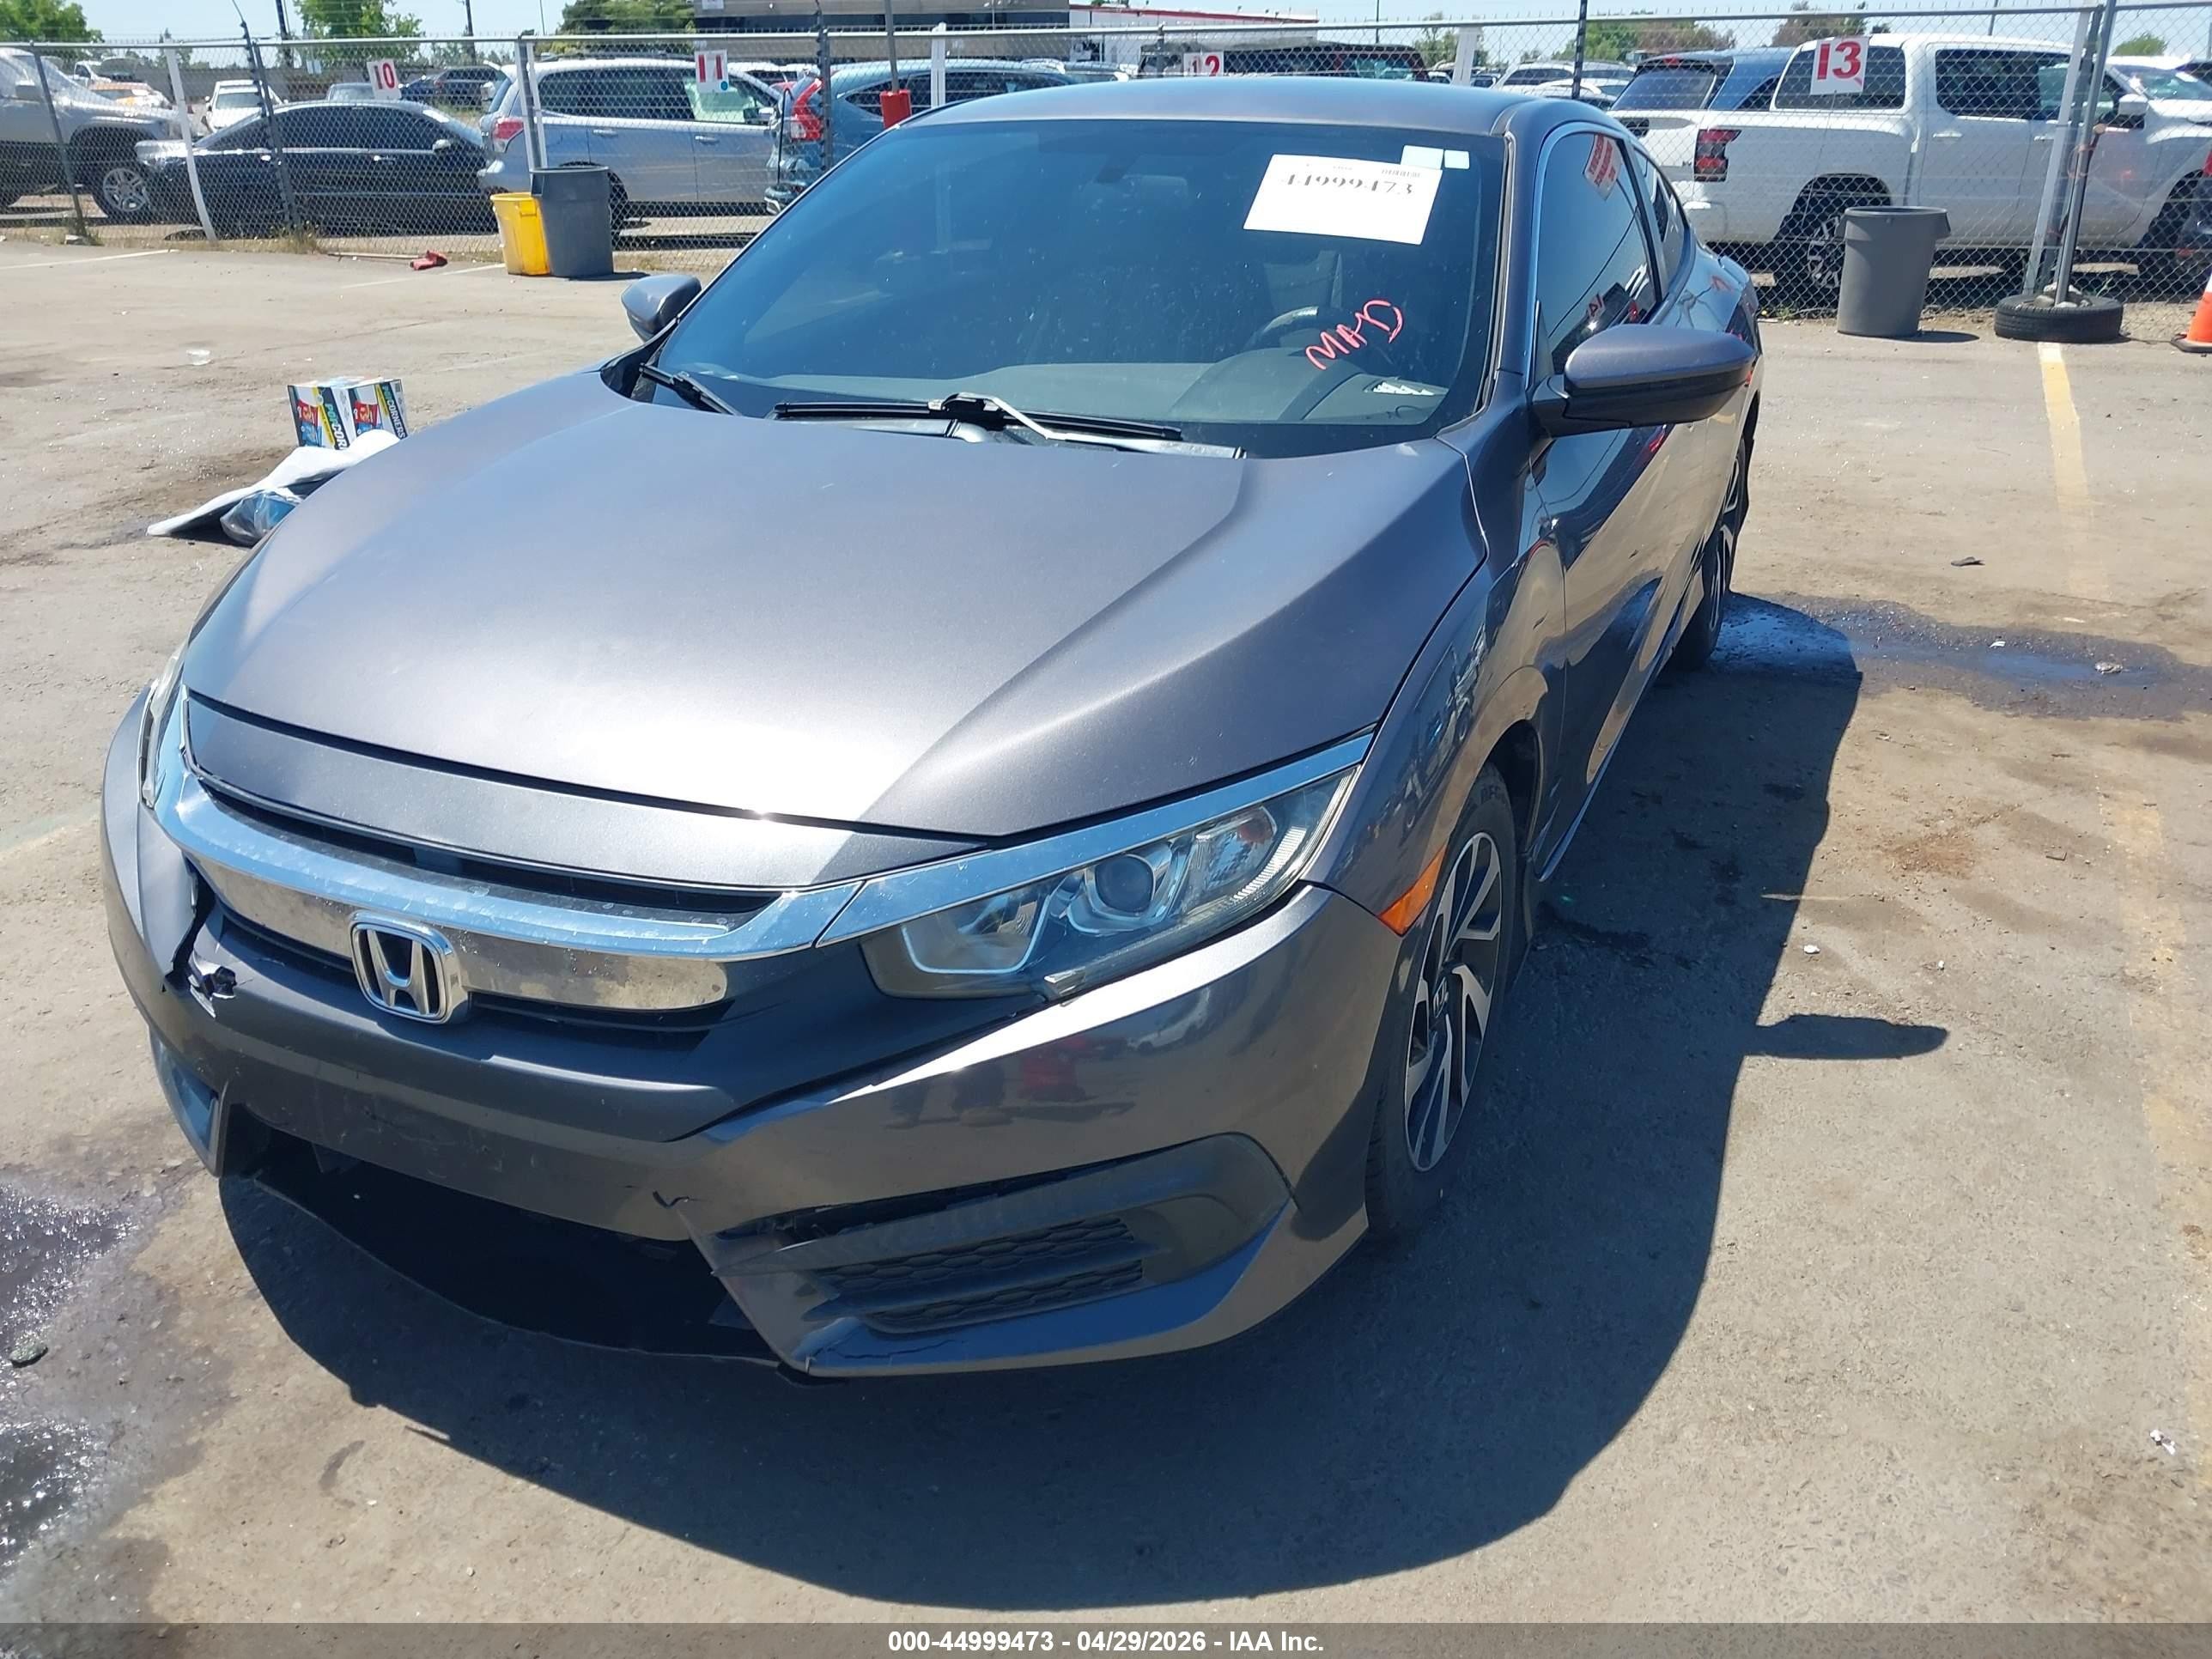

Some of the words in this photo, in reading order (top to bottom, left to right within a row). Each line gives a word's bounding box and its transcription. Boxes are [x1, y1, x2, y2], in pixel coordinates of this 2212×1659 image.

[698, 54, 723, 83] 11
[1817, 40, 1862, 80] 13
[373, 63, 395, 90] 10
